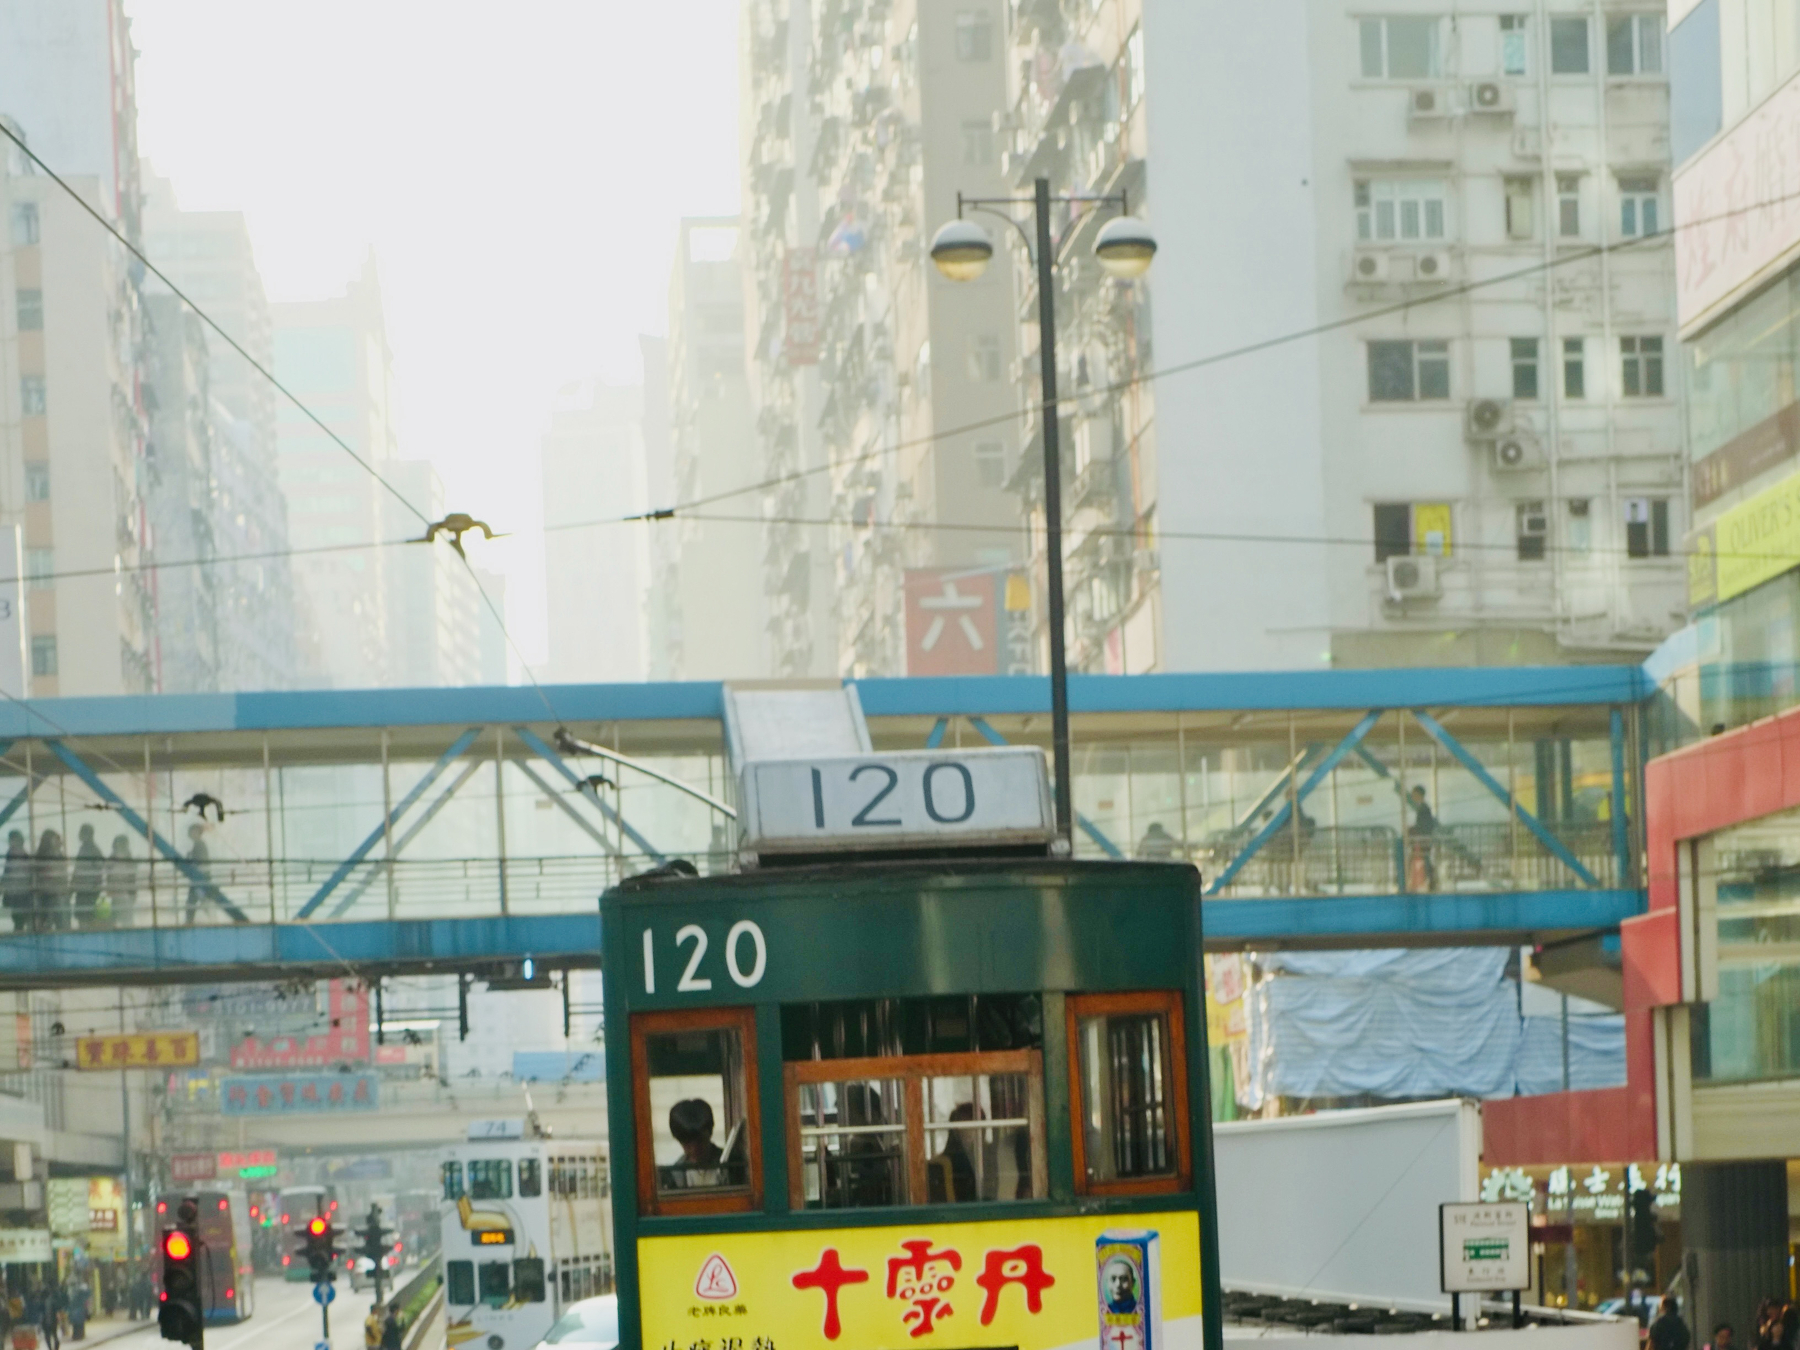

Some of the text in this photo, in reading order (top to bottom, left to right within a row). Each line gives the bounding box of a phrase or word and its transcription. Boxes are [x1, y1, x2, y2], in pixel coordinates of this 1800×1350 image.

[811, 761, 977, 829] 120
[642, 919, 768, 995] 120
[792, 1239, 1055, 1340] 十靈丹
